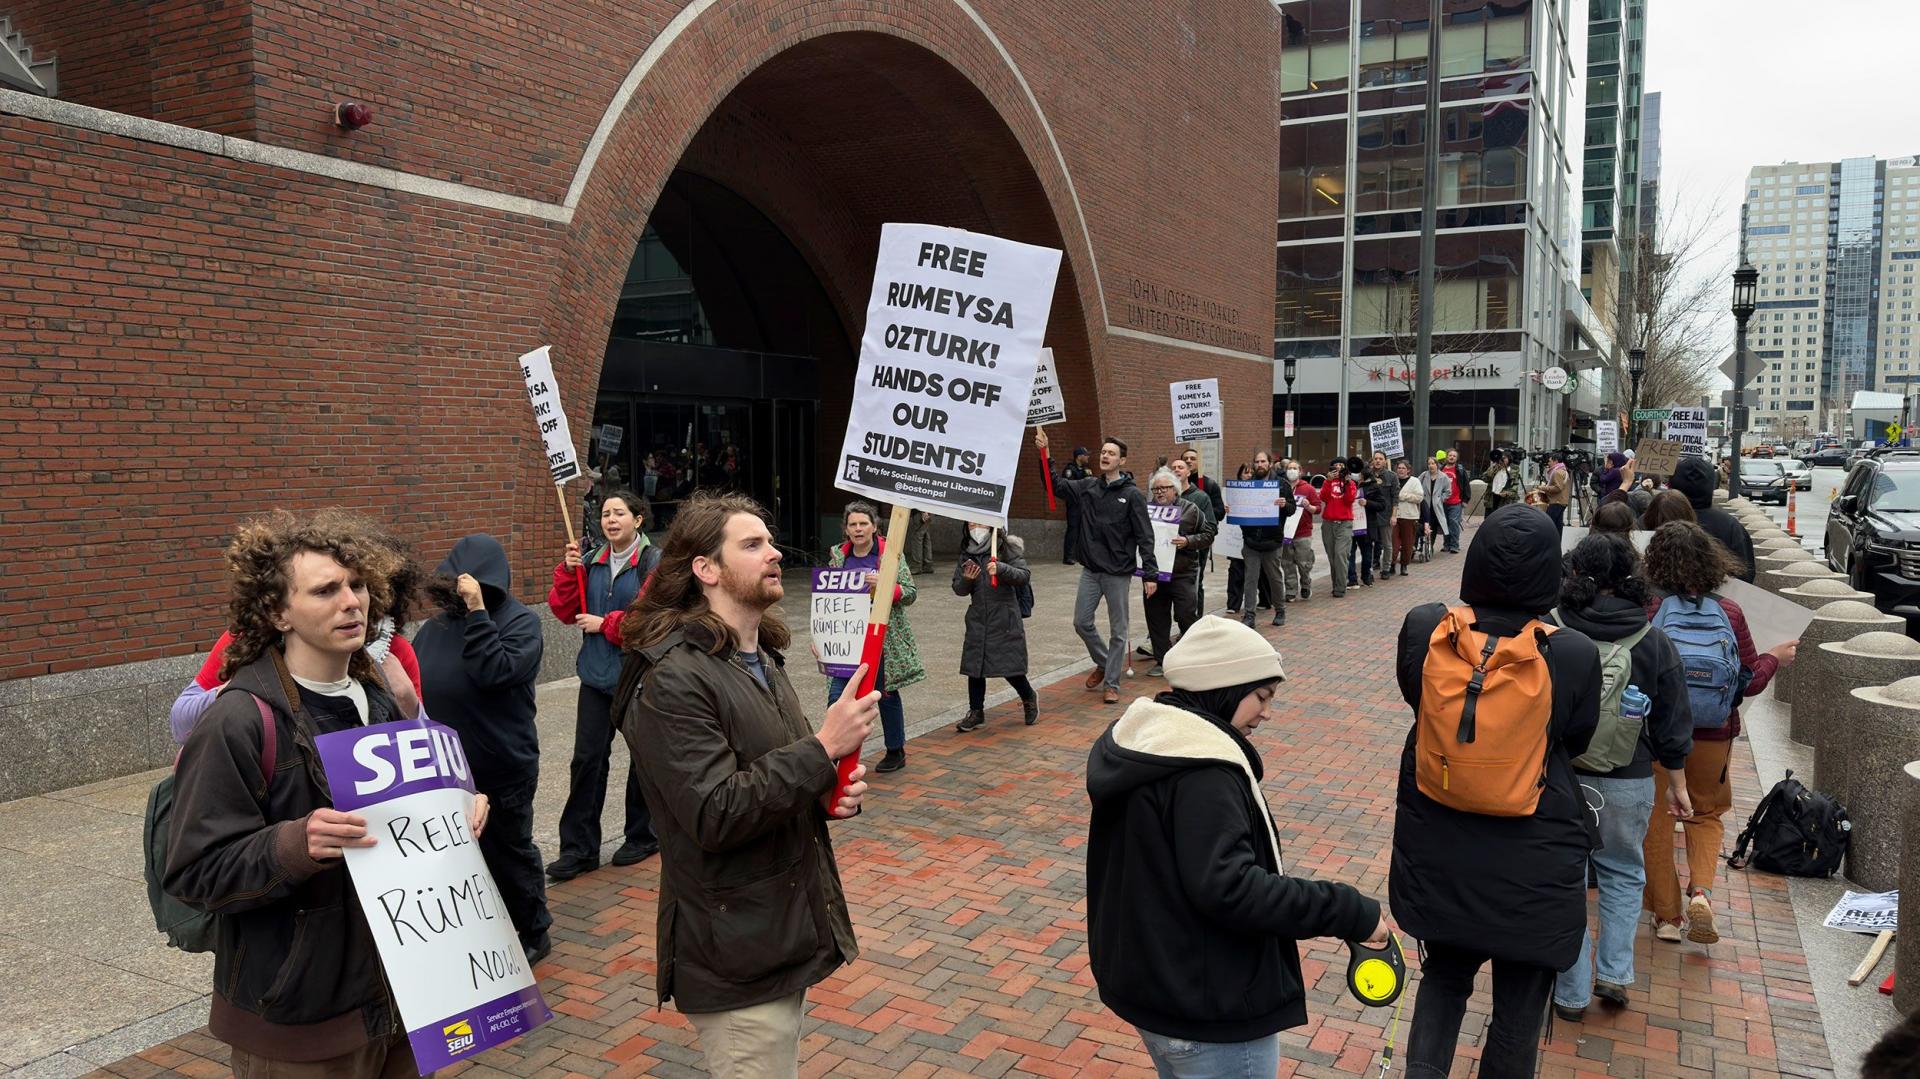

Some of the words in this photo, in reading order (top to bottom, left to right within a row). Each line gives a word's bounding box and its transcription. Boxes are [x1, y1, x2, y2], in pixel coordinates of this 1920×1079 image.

[917, 242, 988, 278] FREE
[886, 281, 1014, 329] RUMEYSA
[1128, 277, 1158, 303] JOHN
[1164, 287, 1199, 312] JOSEPH
[1203, 301, 1240, 325] MOAKLEY
[1128, 304, 1169, 331] UNITED
[1174, 315, 1206, 339] STATES
[1209, 324, 1262, 351] COURTHOUSE
[884, 323, 1000, 369] OZTURK!
[1389, 366, 1451, 381] Leaer
[1452, 363, 1501, 379] Bank
[871, 365, 943, 397] HANDS
[947, 377, 1002, 408] OFF
[1177, 391, 1212, 401] RUMEYSA
[1027, 405, 1055, 416] DENTS!
[1180, 401, 1210, 410] OZTURK!
[892, 402, 948, 434] OUR
[1179, 412, 1200, 420] HANDS
[1692, 411, 1705, 421] ALL
[1181, 426, 1214, 435] STUDENTS!
[1371, 420, 1398, 432] RELEASE
[1667, 421, 1705, 430] PALESTINIAN
[862, 431, 986, 476] STUDENTS!
[1641, 441, 1680, 457] FREE
[1681, 445, 1703, 454] ONERS
[1638, 457, 1670, 472] HER
[865, 465, 881, 476] Party
[880, 468, 891, 477] for
[891, 470, 930, 485] Socialism
[931, 479, 949, 489] and
[951, 482, 995, 497] Liberation
[894, 481, 947, 498] @bostonpsl
[816, 571, 865, 590] SEIU
[815, 597, 856, 614] FREE
[823, 641, 851, 657] NOW
[352, 728, 469, 796] SEIU
[486, 1011, 505, 1024] Service
[447, 1034, 474, 1053] SEIU
